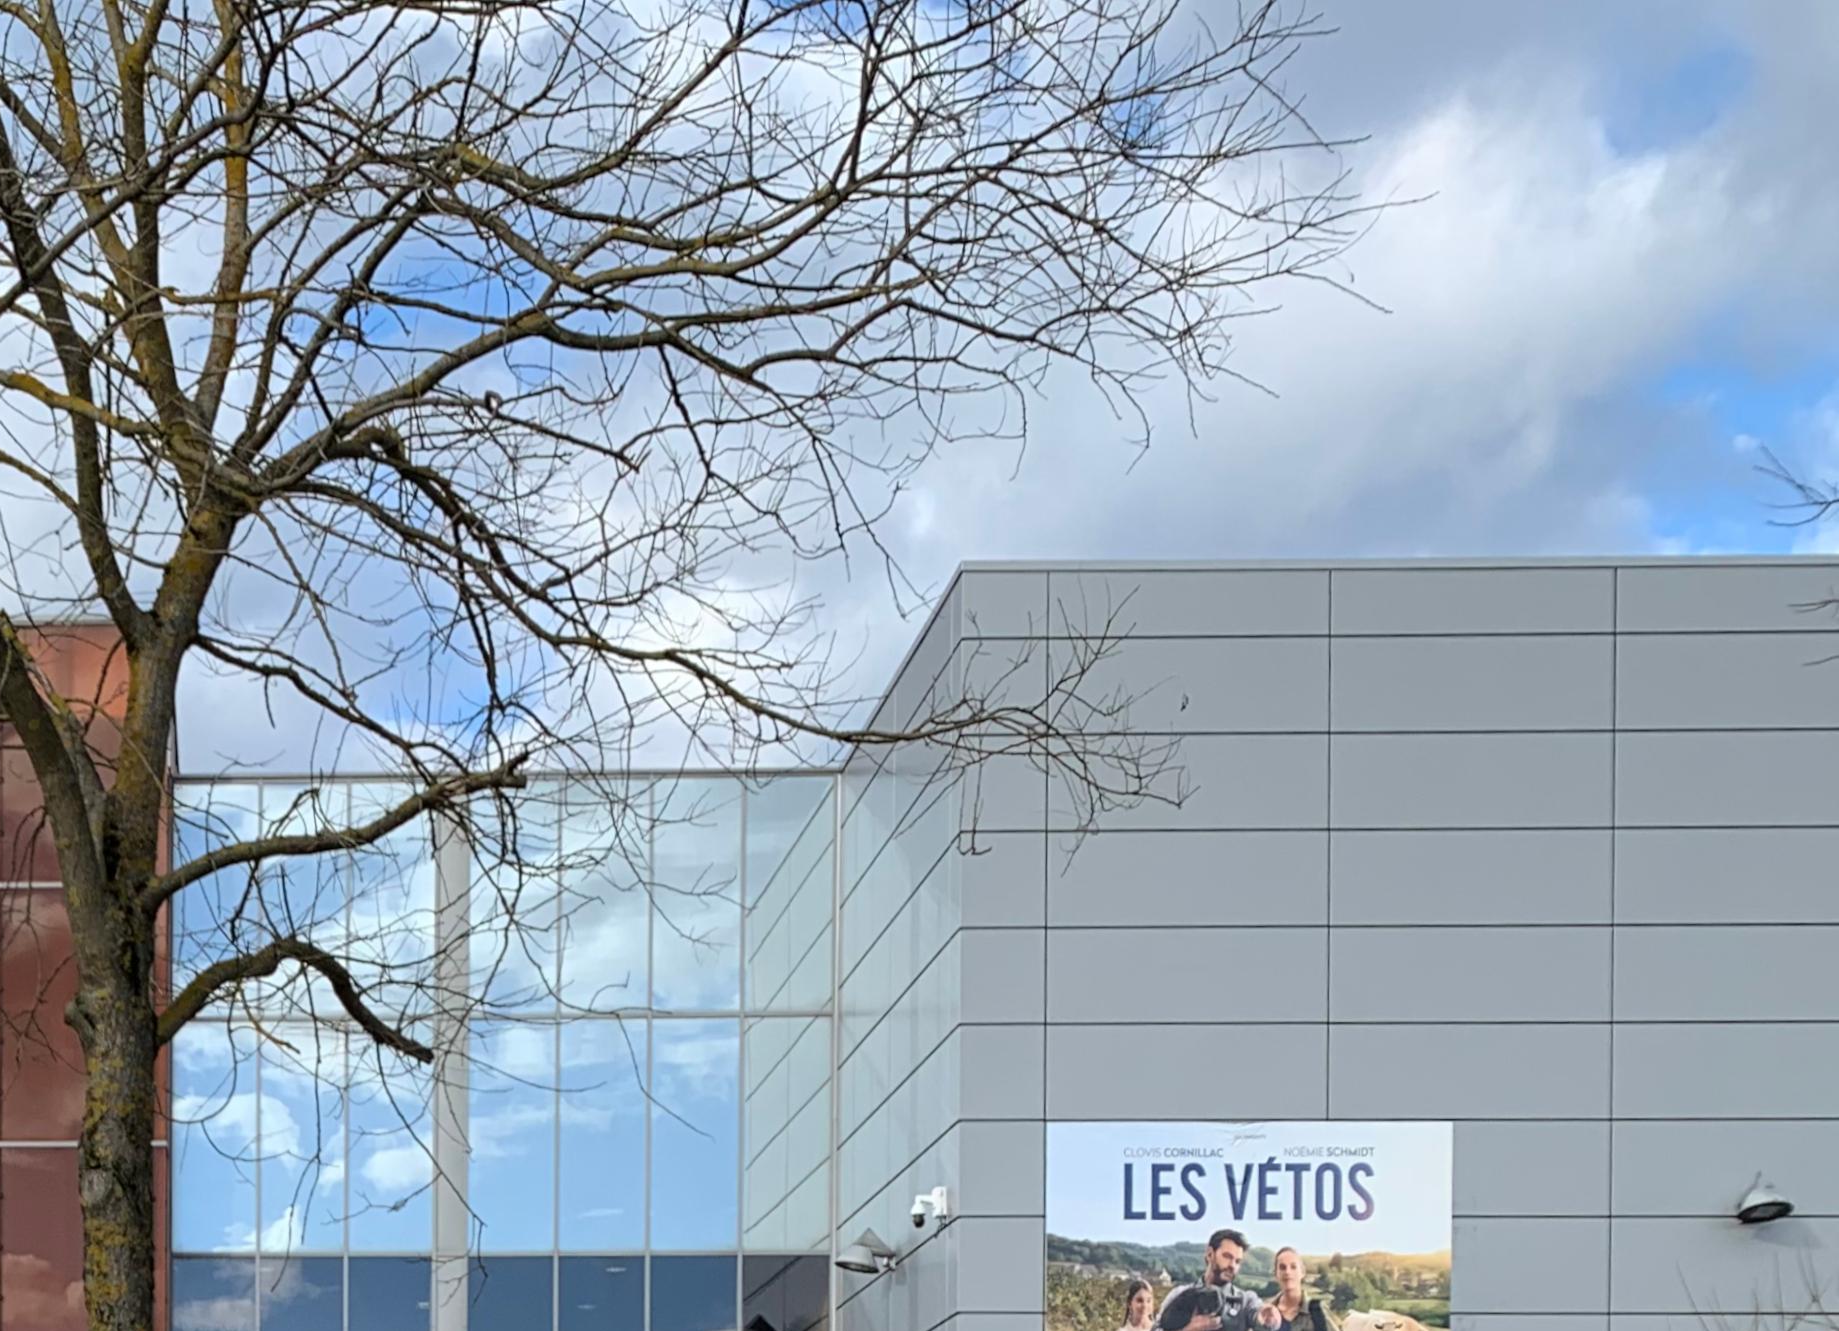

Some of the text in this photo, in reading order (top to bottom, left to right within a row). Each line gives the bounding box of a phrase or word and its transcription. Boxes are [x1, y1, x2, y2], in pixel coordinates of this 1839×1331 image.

[1123, 1147, 1224, 1158] CLOVIS CORNILLAC
[1326, 1146, 1375, 1157] SCHMIDT
[1123, 1156, 1375, 1222] LES VÉTOS
